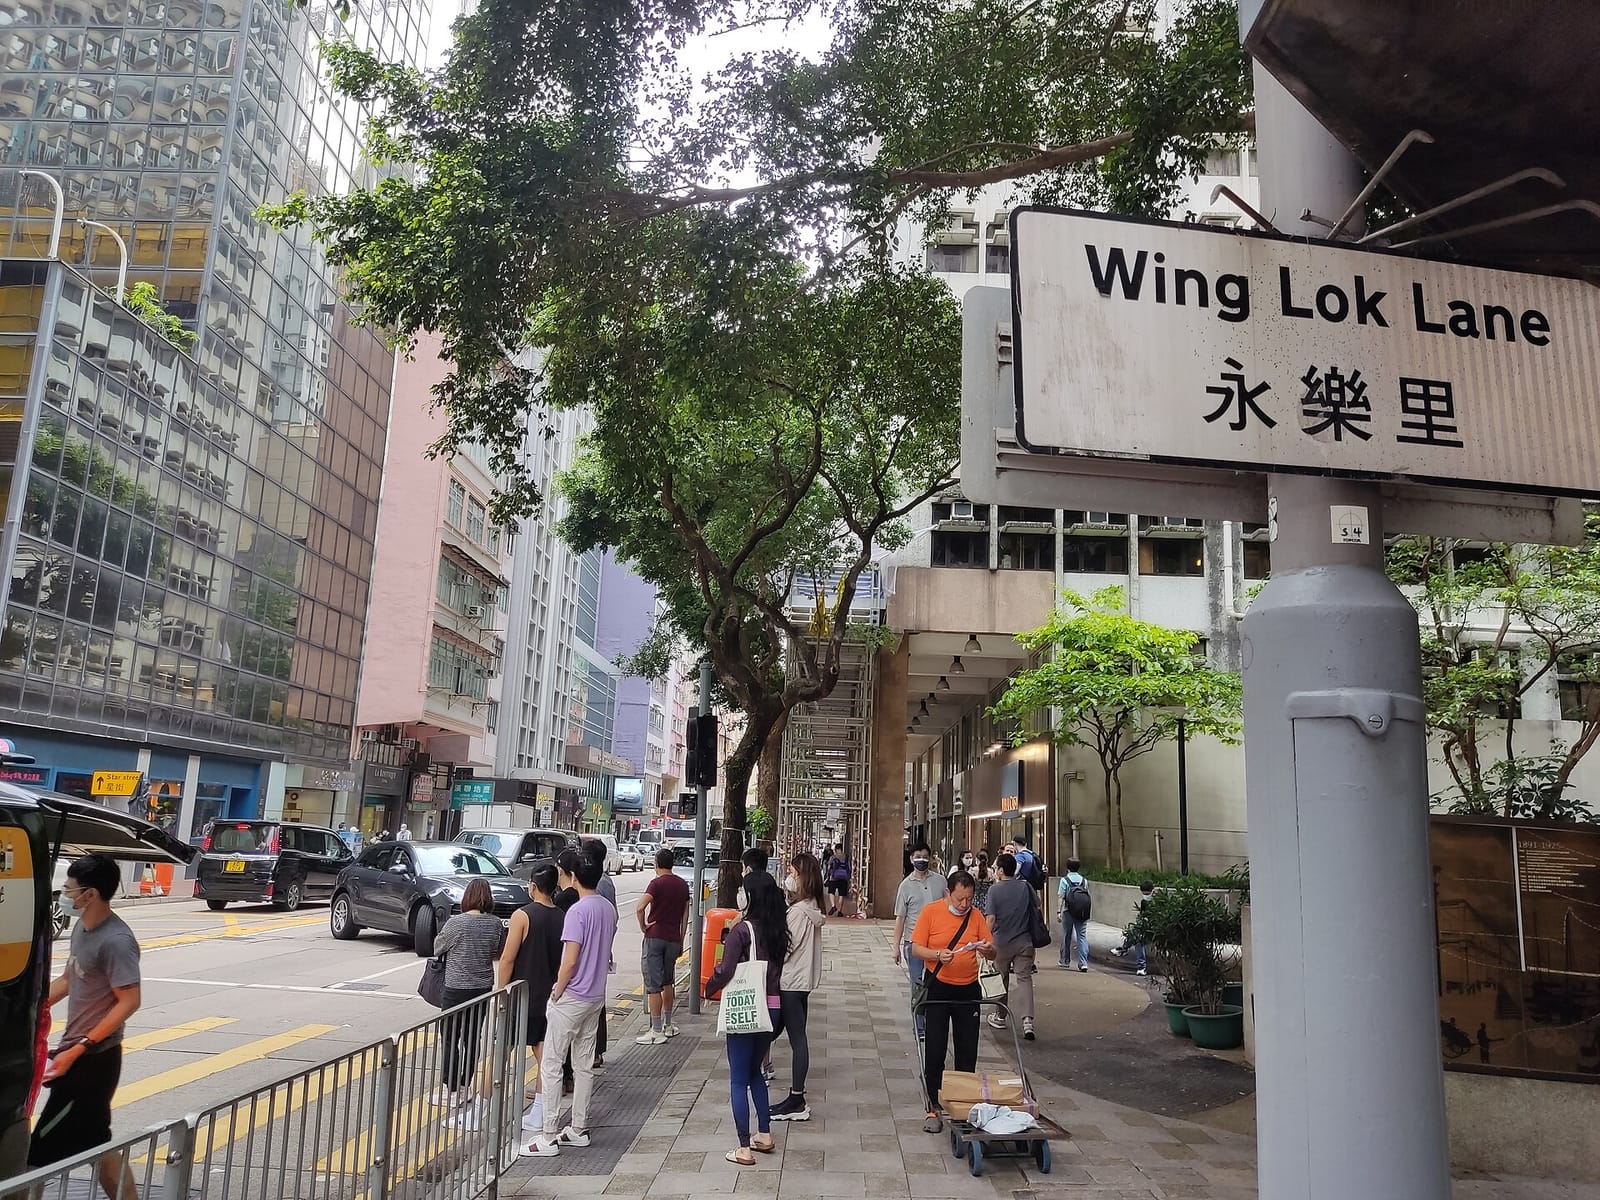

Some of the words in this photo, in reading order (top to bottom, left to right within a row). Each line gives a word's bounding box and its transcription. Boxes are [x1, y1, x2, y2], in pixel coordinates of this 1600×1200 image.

[1085, 244, 1250, 322] Wing
[1279, 266, 1390, 328] Lok
[1412, 282, 1551, 346] Lane
[1203, 357, 1464, 448] 永樂里
[726, 995, 755, 1007] TODAY
[731, 1011, 757, 1024] SELF
